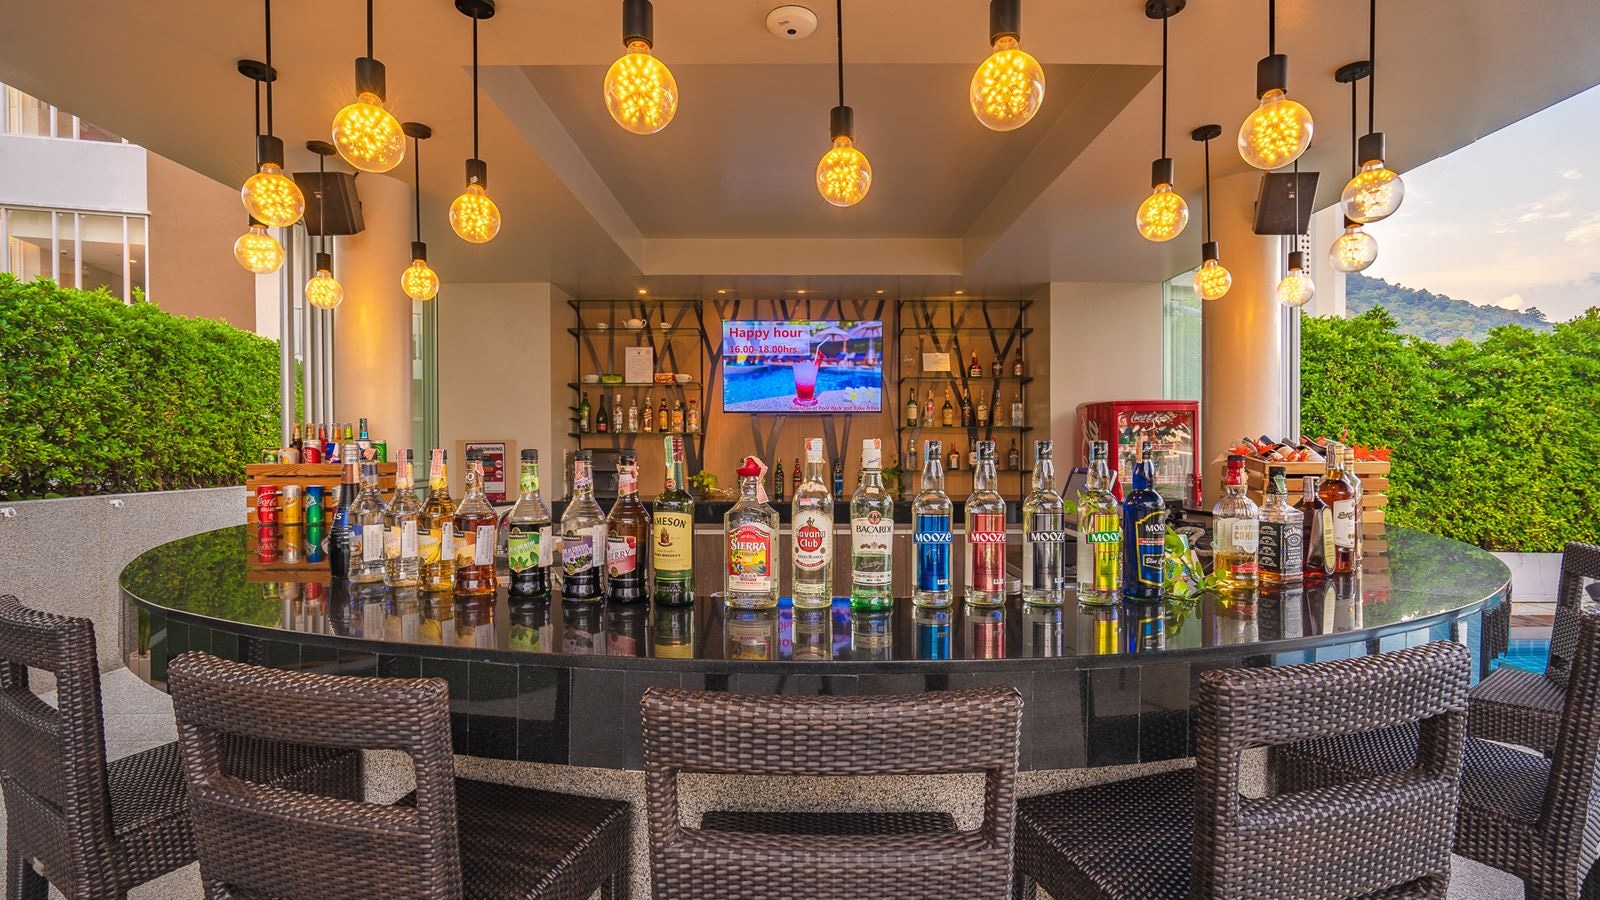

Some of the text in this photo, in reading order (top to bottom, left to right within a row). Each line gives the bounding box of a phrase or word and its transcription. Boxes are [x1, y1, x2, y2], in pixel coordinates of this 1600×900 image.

[729, 327, 803, 341] Happy hour
[729, 345, 800, 353] 16.00-18.00hrs.
[856, 525, 892, 533] BACARDI
[731, 538, 767, 551] SIERRA
[800, 538, 819, 548] Club
